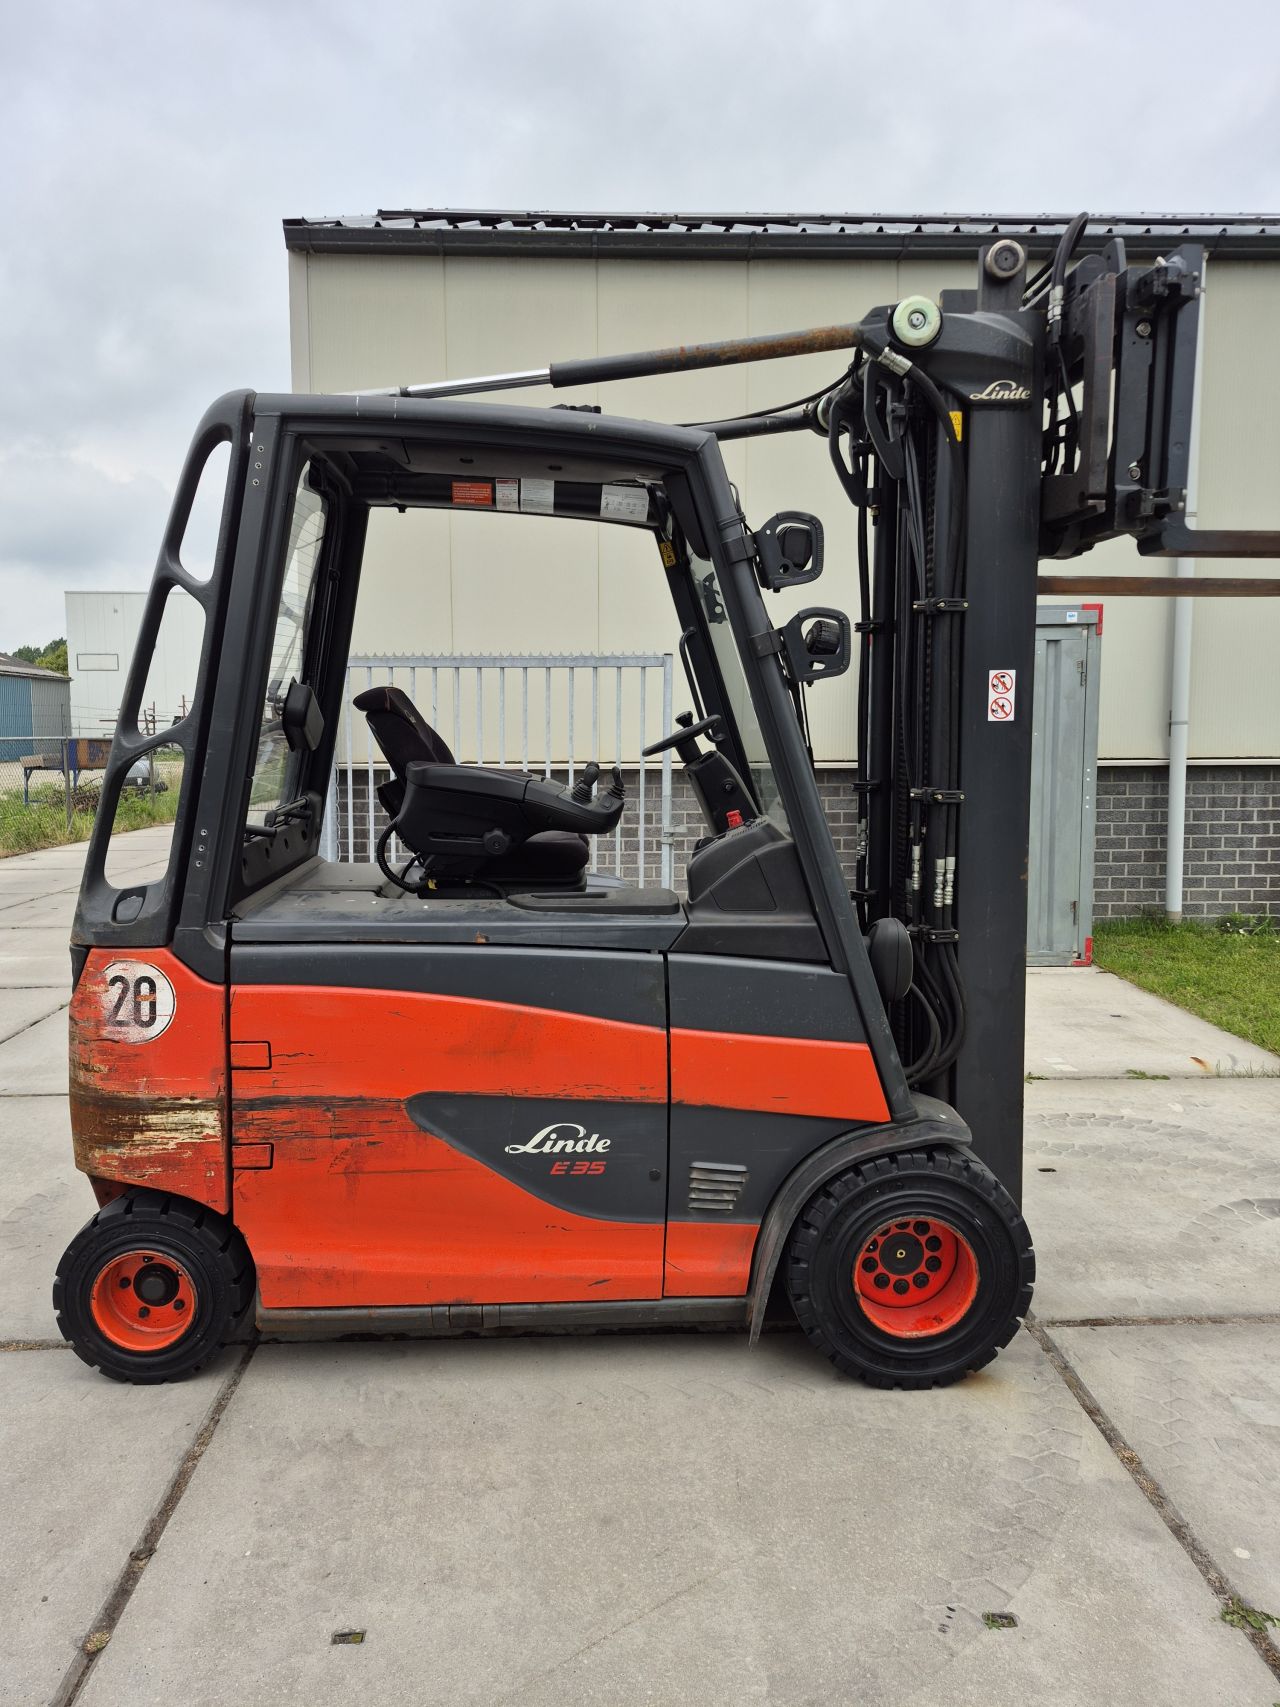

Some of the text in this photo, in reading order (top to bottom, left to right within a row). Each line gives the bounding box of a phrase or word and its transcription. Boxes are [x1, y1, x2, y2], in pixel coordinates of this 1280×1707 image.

[969, 380, 1031, 400] Linde
[107, 975, 157, 1028] 20
[504, 1123, 611, 1154] Linde
[570, 1161, 607, 1175] 35
